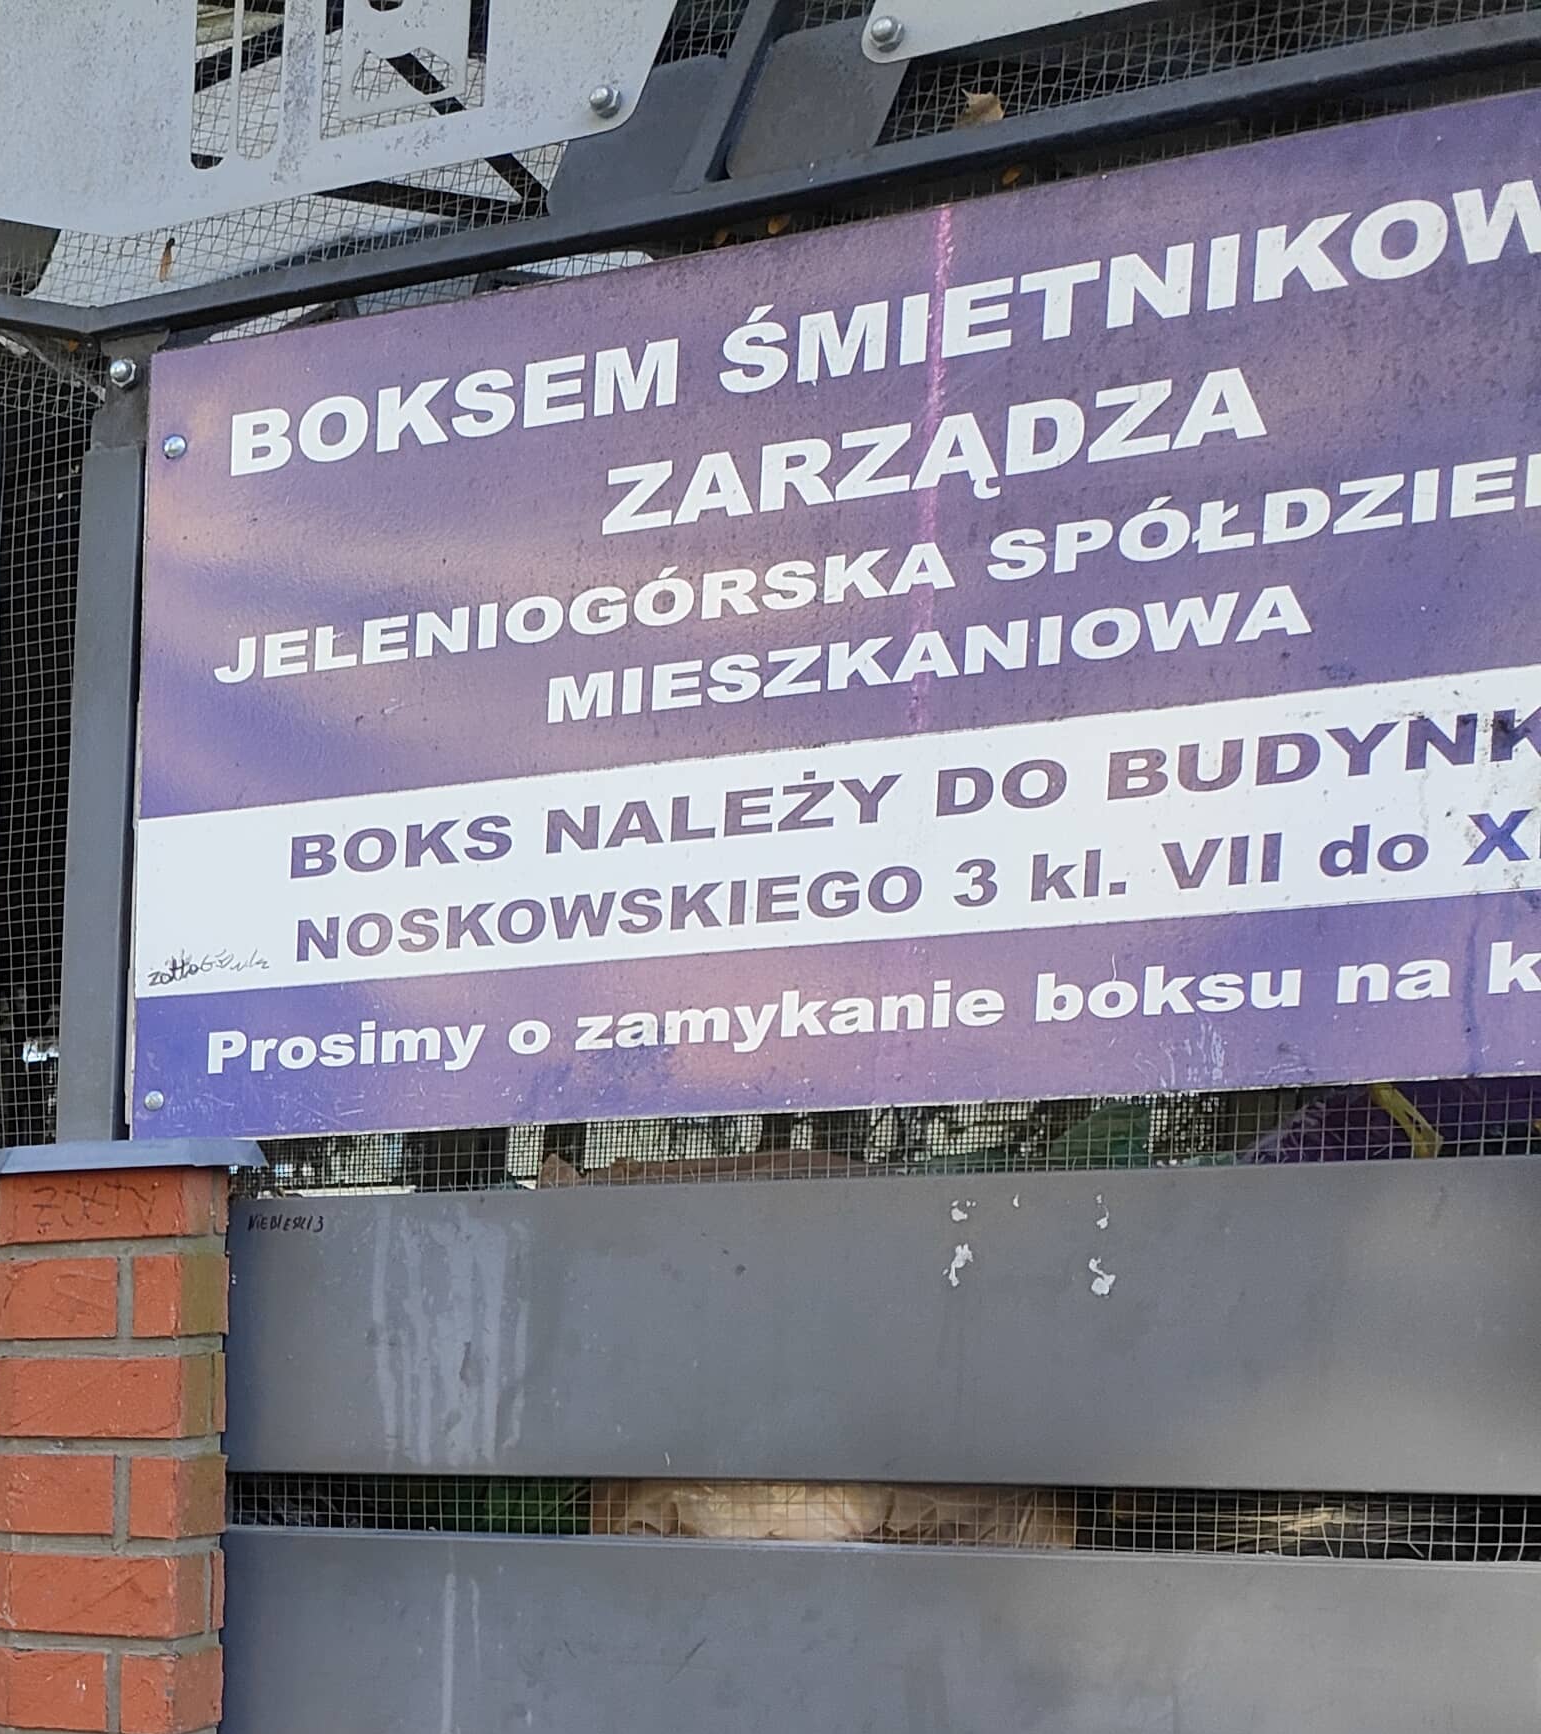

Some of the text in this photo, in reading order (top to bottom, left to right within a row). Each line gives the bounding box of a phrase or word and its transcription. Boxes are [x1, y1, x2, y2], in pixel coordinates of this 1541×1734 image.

[229, 338, 679, 477] BOKSEM
[601, 367, 1267, 536] ZARZĄDZA
[213, 541, 955, 685] JELENIOGÓRSKA
[547, 585, 1313, 725] MIESZKANIOWA
[289, 815, 513, 880] BOKS
[544, 770, 903, 855] NALEŻY
[935, 759, 1068, 818] DO
[295, 866, 922, 963] NOSKOWSKIEGO
[952, 858, 999, 908] 3
[1029, 848, 1127, 903] kl.
[1161, 832, 1283, 890] VII
[1318, 825, 1429, 879] do
[1462, 807, 1541, 867] X
[207, 1019, 486, 1075] Prosimy
[507, 1019, 552, 1056] o
[575, 980, 1005, 1052] zamykanie
[1034, 965, 1303, 1024] boksu
[1335, 958, 1452, 1005] na
